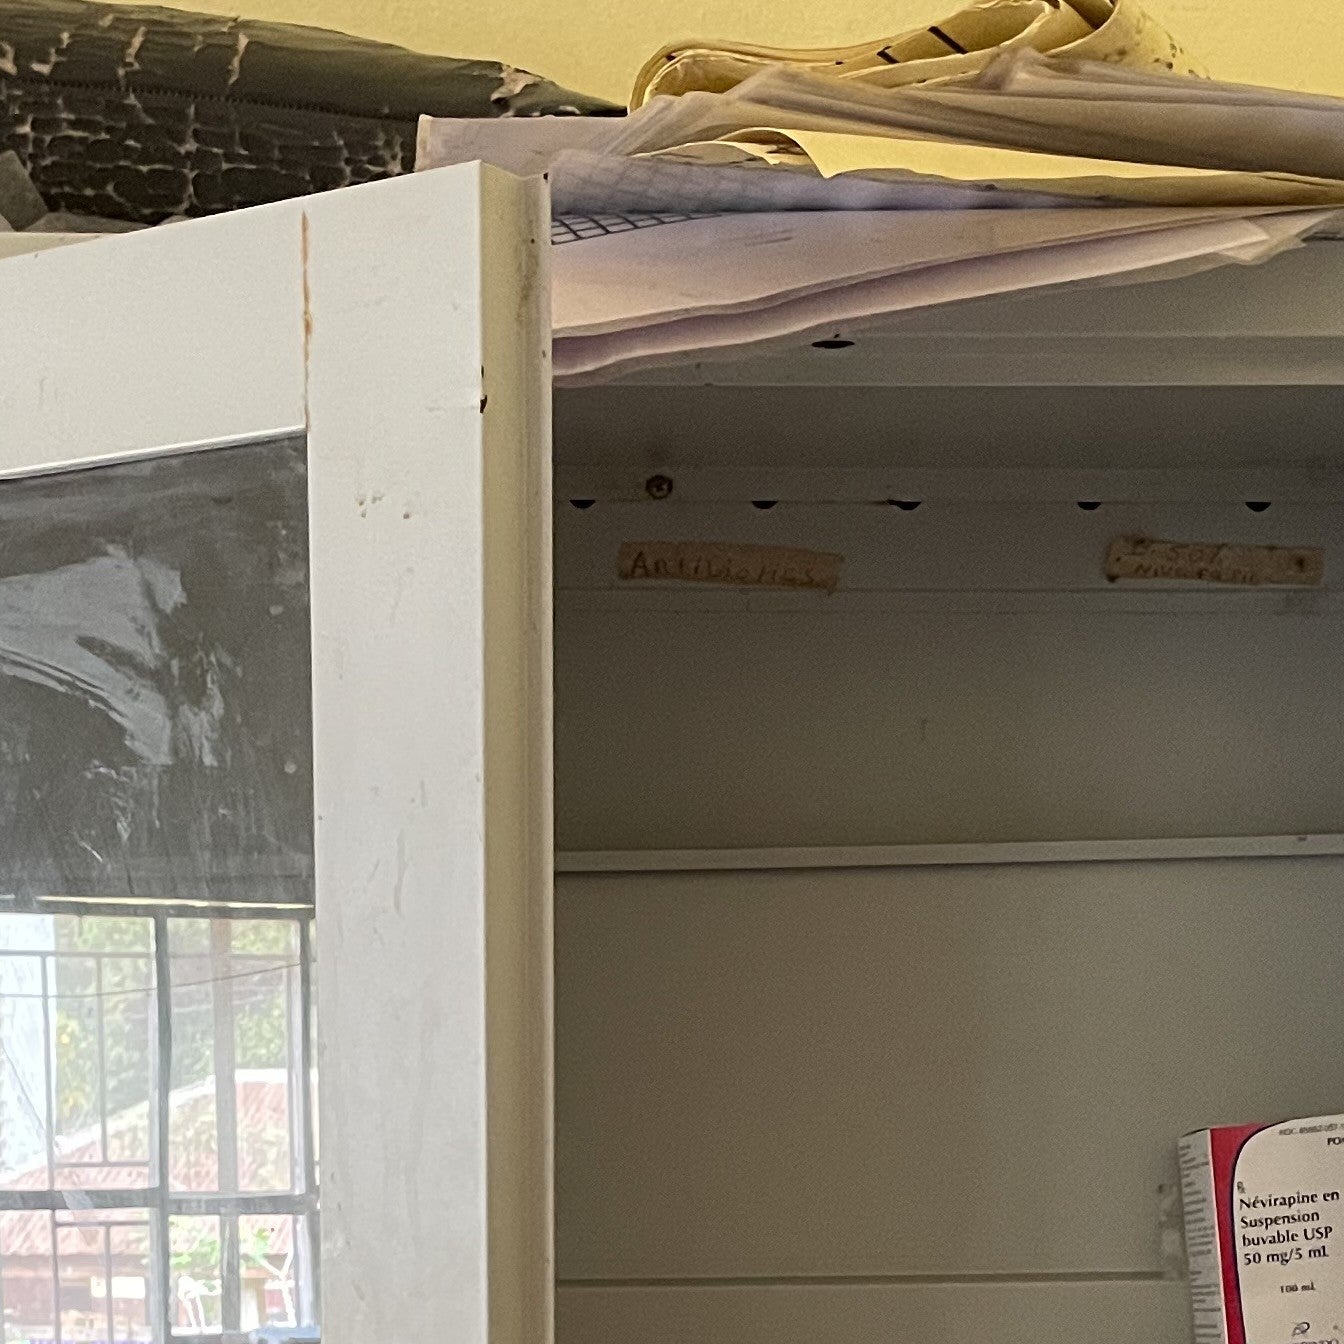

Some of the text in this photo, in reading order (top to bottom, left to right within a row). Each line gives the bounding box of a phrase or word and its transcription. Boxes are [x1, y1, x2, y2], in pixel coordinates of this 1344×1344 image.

[1239, 1190, 1340, 1211] Névirapine en
[1240, 1210, 1320, 1230] Suspension
[1242, 1226, 1333, 1248] buvable USP
[1244, 1253, 1261, 1266] 50
[1267, 1248, 1303, 1266] mg/5
